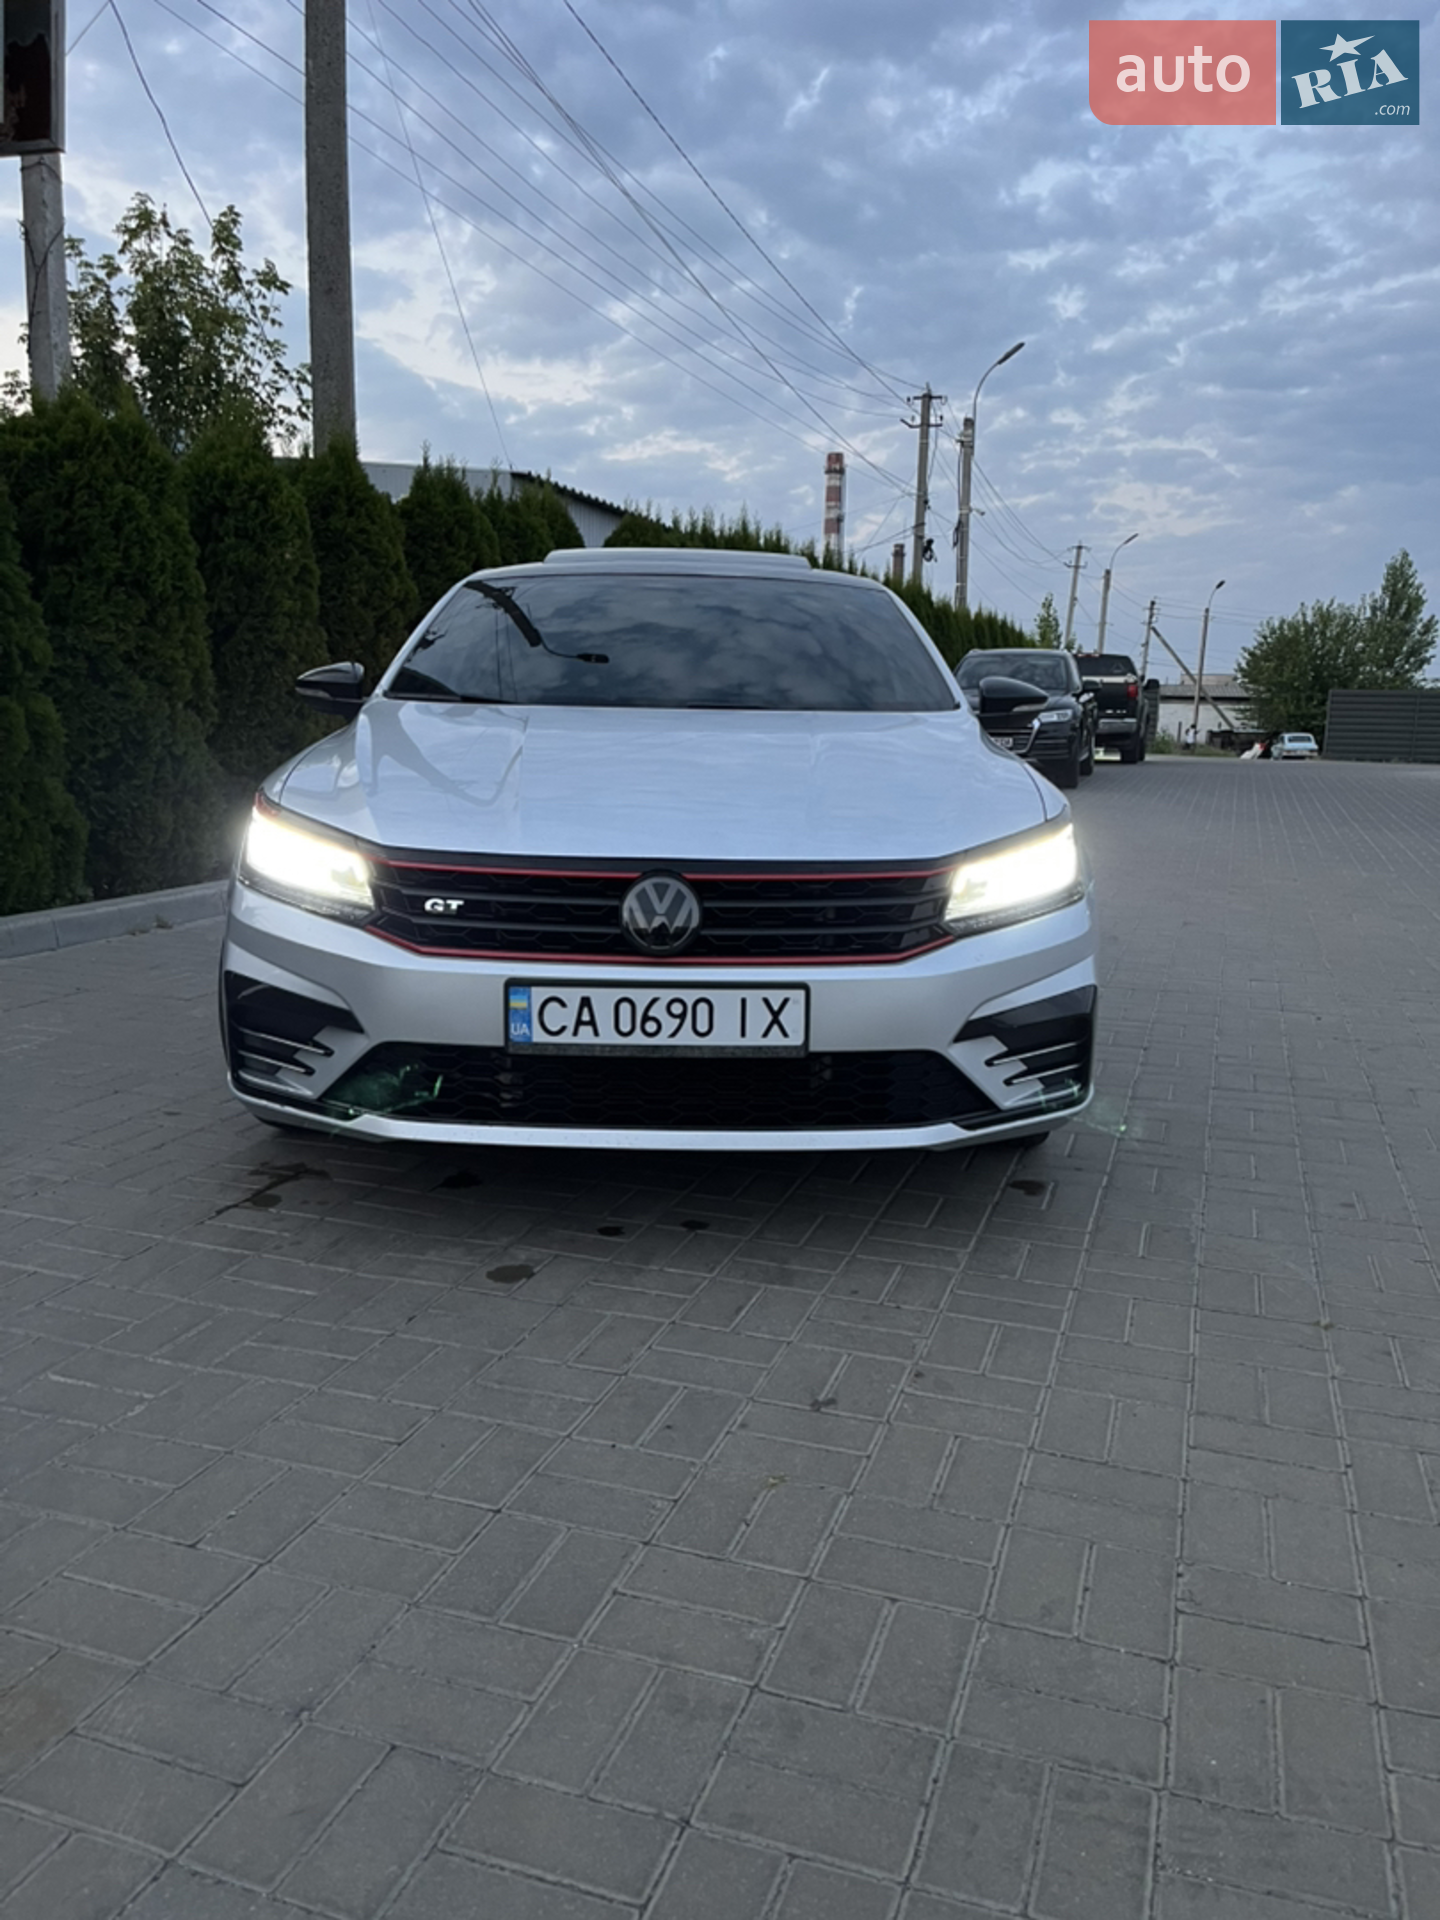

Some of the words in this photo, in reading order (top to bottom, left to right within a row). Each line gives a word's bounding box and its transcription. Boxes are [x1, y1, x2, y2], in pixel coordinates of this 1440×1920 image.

[424, 898, 464, 914] GT
[538, 995, 600, 1037] CA
[613, 997, 714, 1038] 0690
[740, 997, 790, 1038] IX
[511, 1023, 530, 1036] UA
